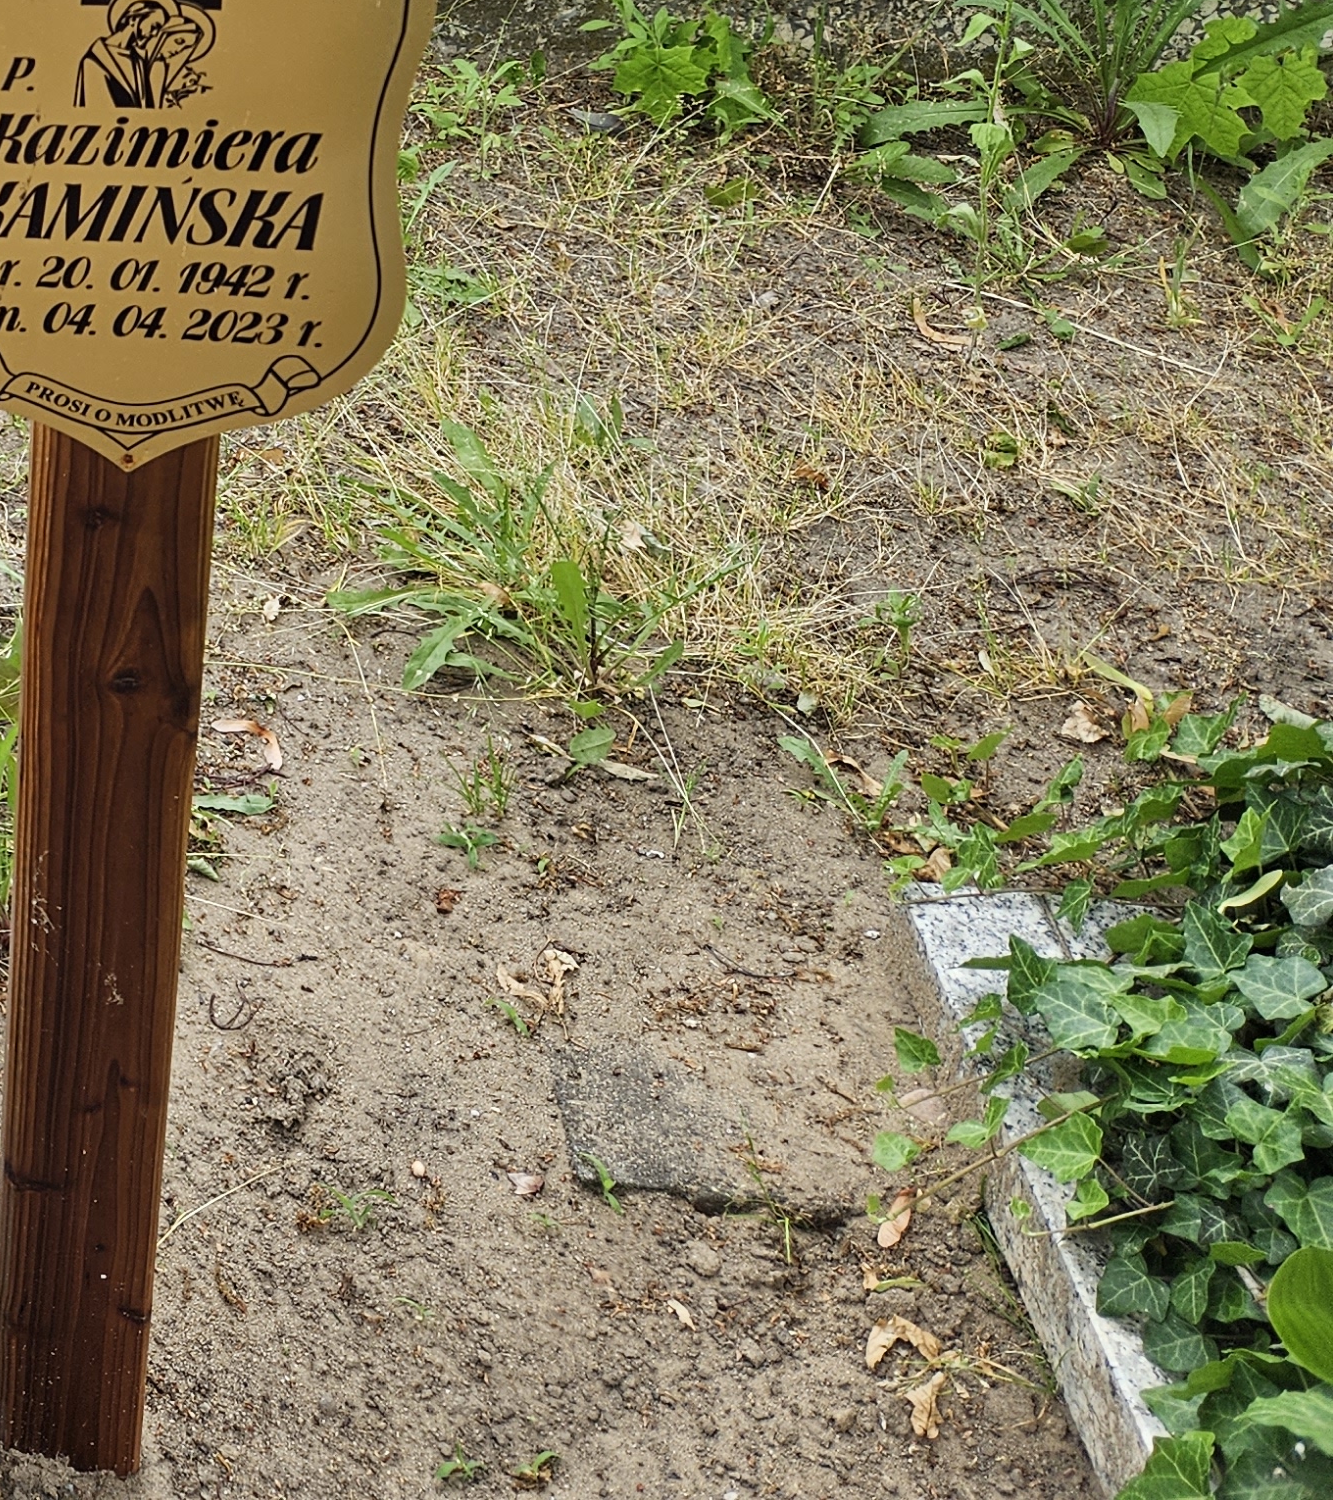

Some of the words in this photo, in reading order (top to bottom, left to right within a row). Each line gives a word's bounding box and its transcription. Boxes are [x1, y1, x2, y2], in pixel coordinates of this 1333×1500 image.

[0, 57, 36, 92] P.
[35, 255, 94, 290] 20.
[110, 257, 160, 293] 01.
[178, 260, 275, 299] 1942
[283, 271, 310, 301] r.
[42, 300, 96, 336] 04.
[112, 304, 167, 340] 04.
[180, 307, 290, 346] 2023
[296, 319, 323, 348] r.
[24, 381, 93, 417] PROSI
[94, 408, 112, 422] O
[115, 390, 245, 428] MODLITWĘ
